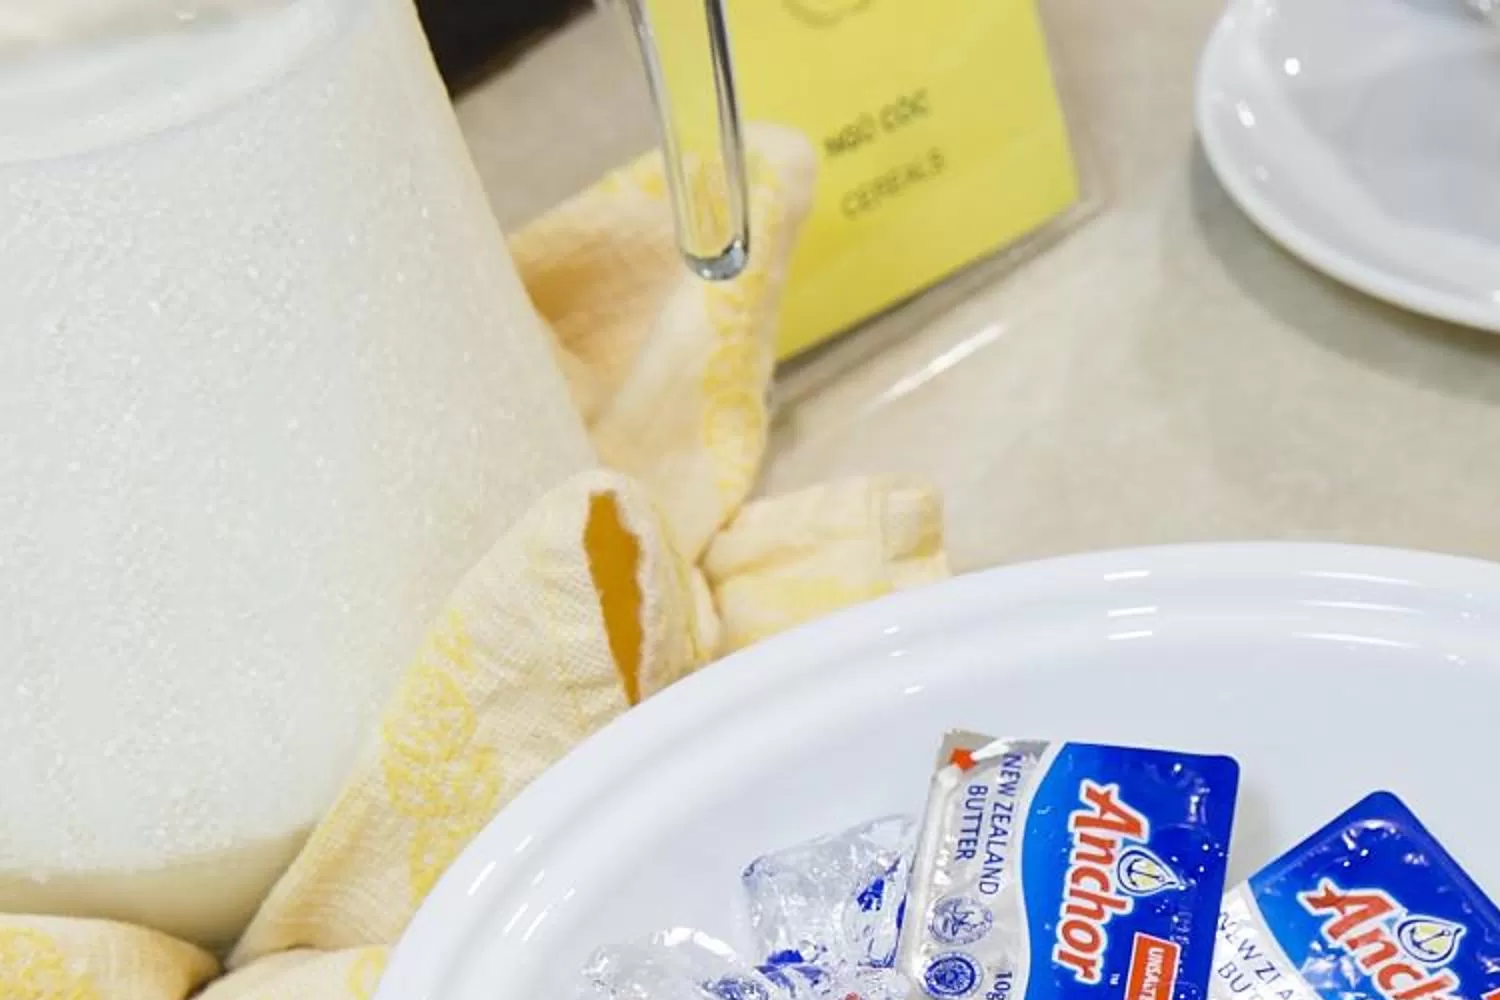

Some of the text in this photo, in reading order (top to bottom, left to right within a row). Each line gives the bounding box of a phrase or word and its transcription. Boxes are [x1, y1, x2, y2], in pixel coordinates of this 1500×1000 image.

[956, 783, 988, 861] BUTTER
[978, 752, 1023, 896] NEW ZEALAND
[1053, 779, 1150, 984] Anchor
